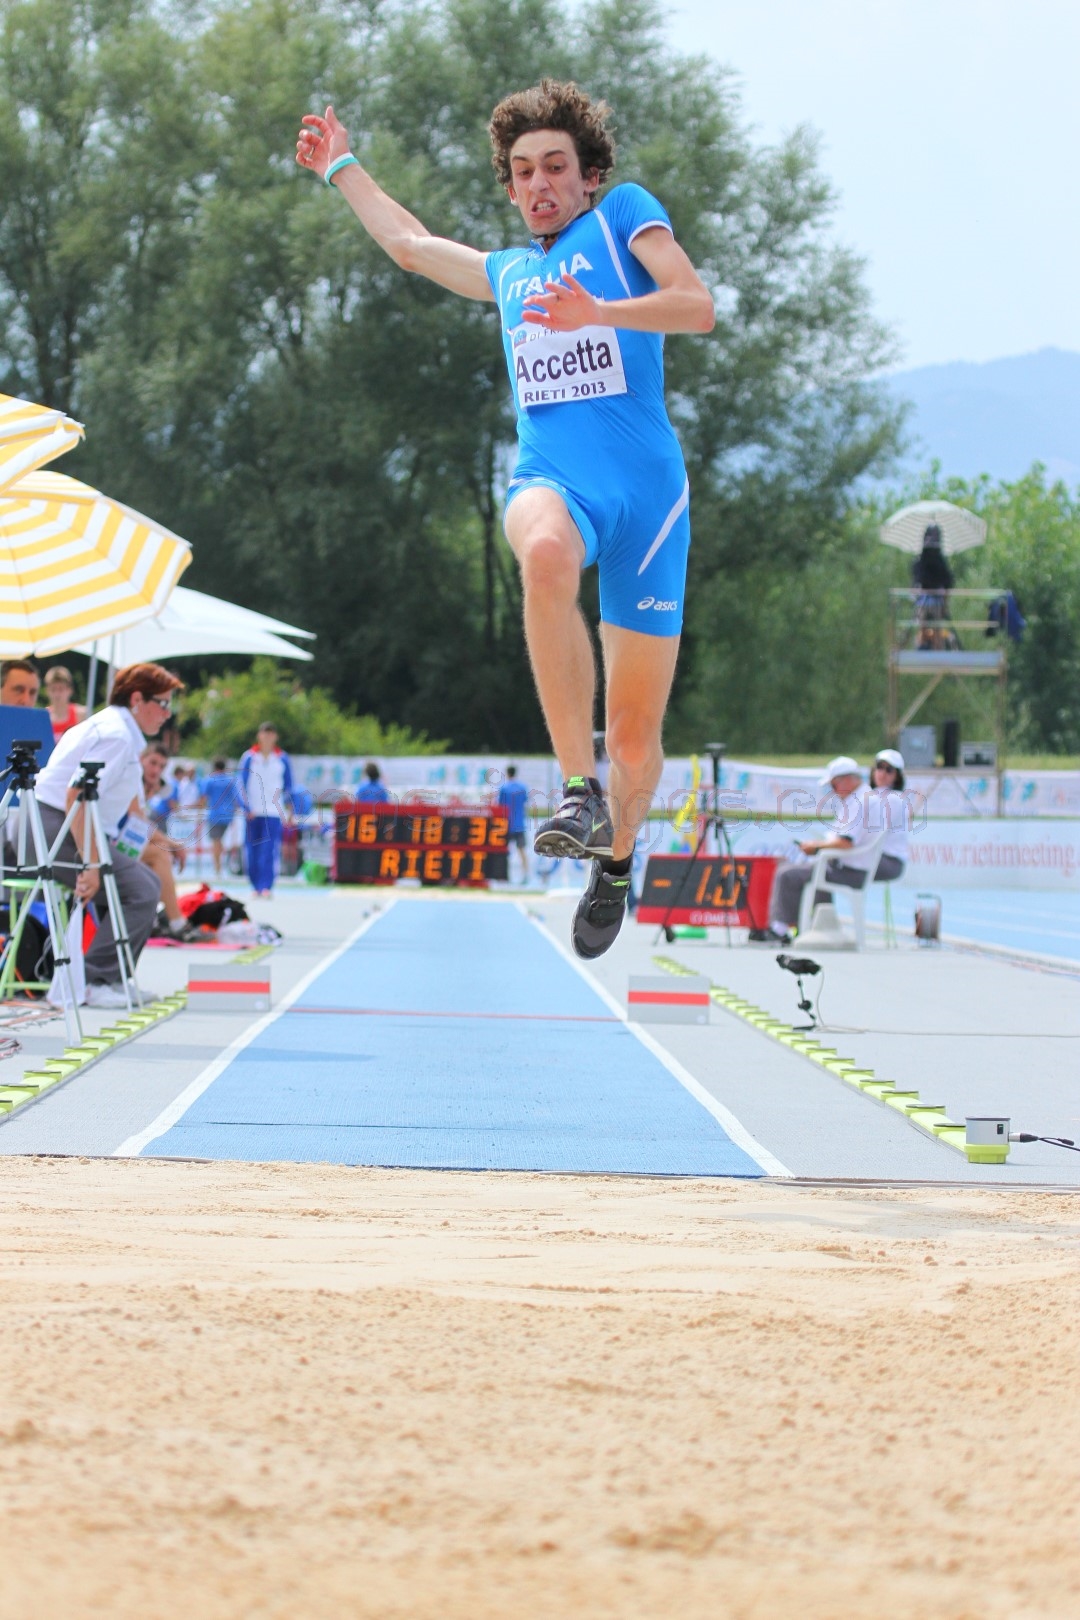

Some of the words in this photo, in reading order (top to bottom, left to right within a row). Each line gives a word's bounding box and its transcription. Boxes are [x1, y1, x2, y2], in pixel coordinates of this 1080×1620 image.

[506, 252, 593, 301] ITALIA
[516, 337, 613, 383] Accetta
[524, 388, 566, 403] RIETI
[572, 381, 607, 398] 2013
[379, 849, 487, 880] RIETI
